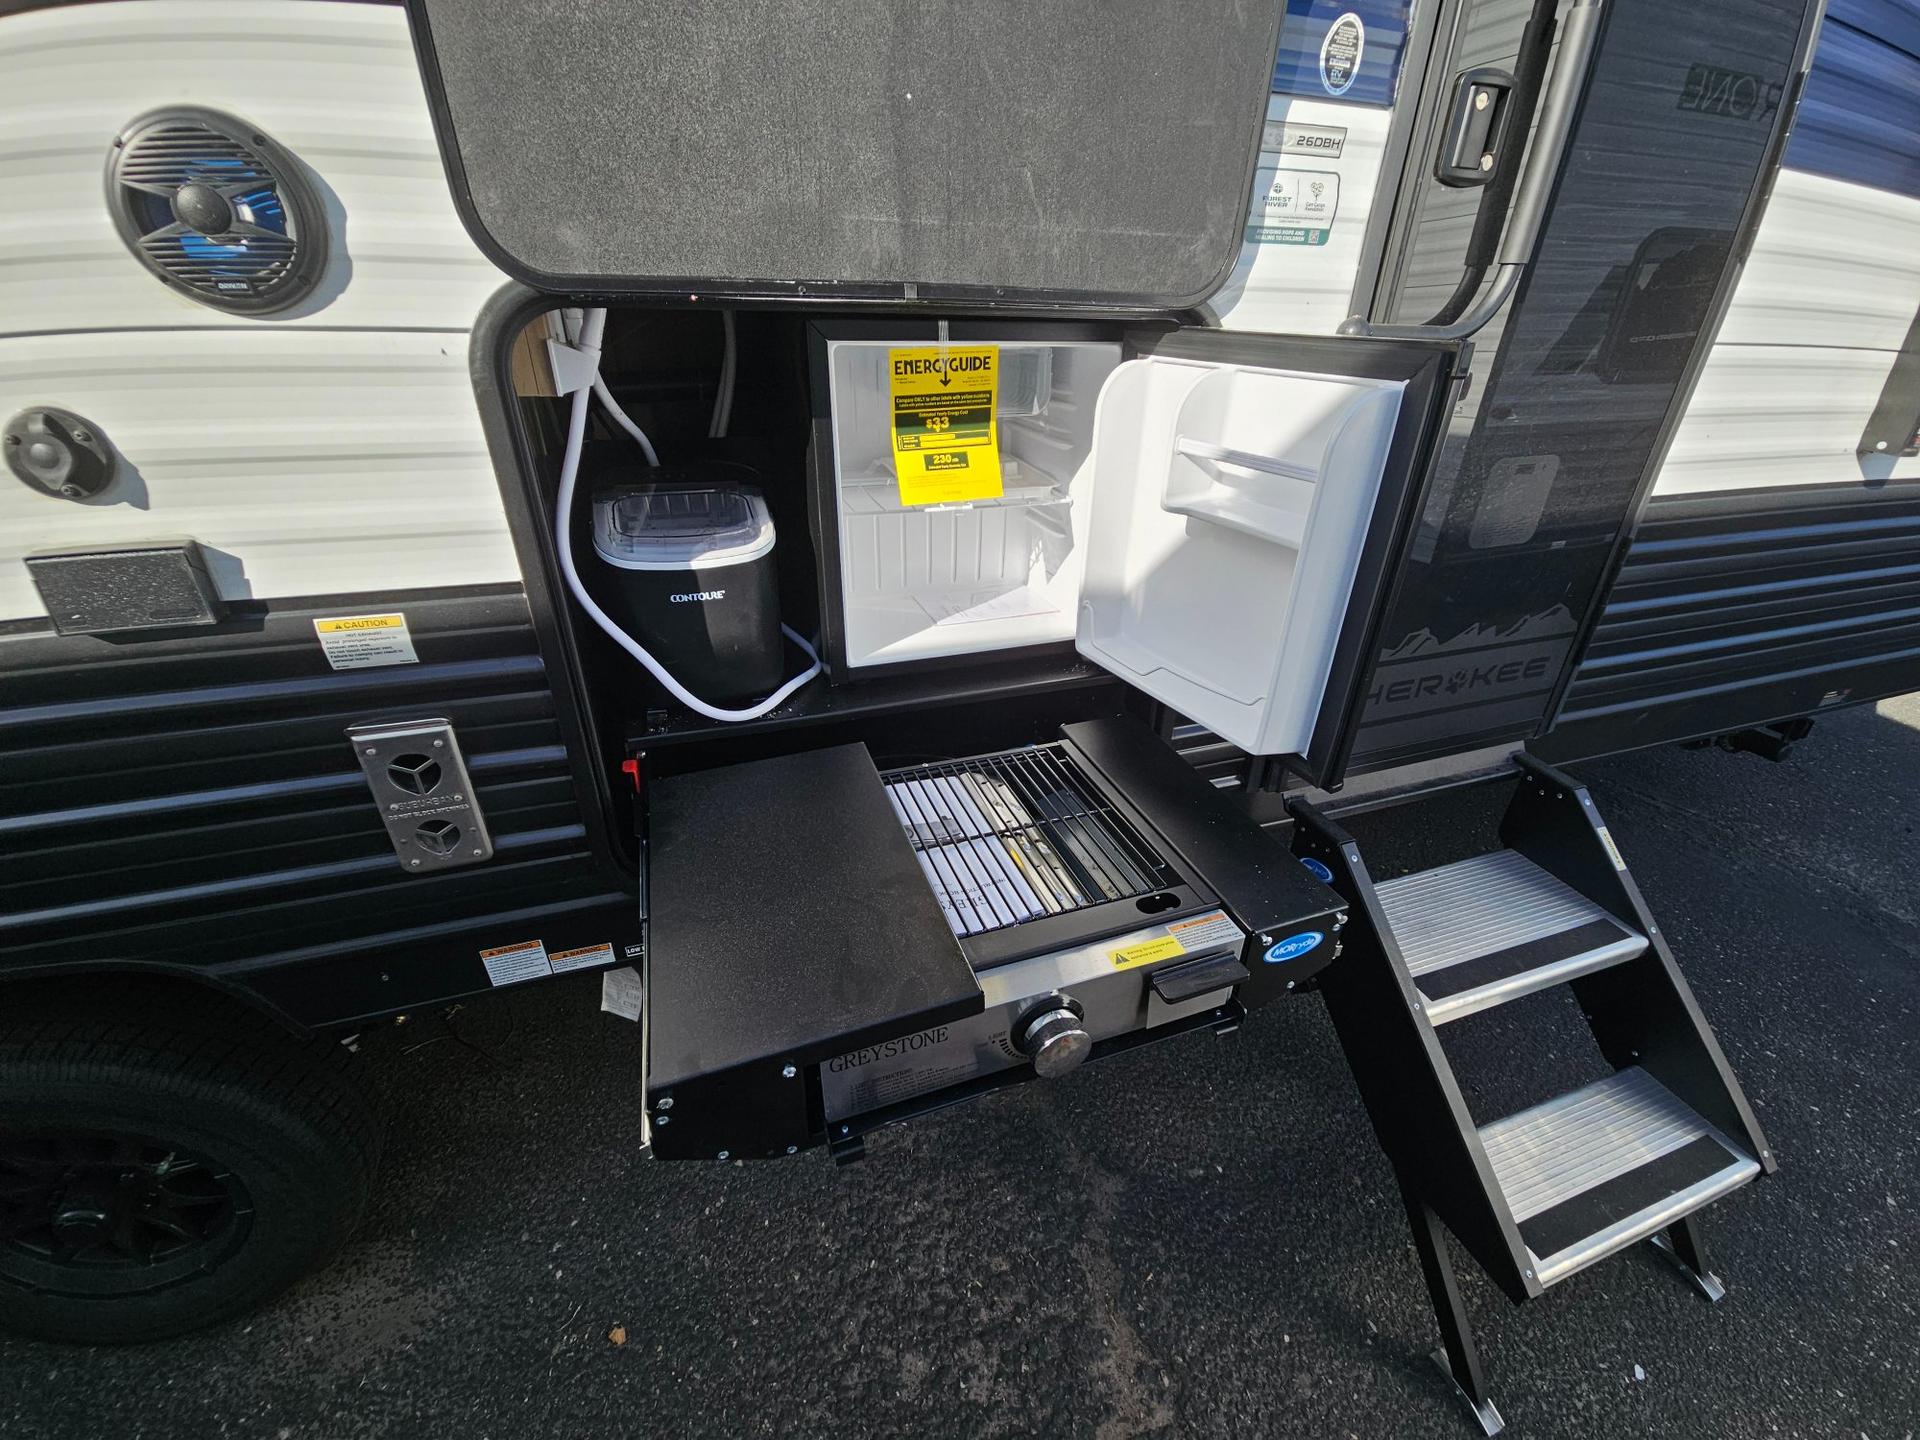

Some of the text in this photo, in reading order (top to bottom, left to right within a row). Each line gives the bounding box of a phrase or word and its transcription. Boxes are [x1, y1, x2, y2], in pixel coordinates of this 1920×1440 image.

[1296, 136, 1341, 149] 26DBH
[932, 454, 952, 464] 230
[670, 591, 724, 603] CONTOURE
[344, 620, 388, 629] CAUTION
[398, 796, 453, 810] SUBURBAN
[829, 1026, 949, 1073] GREYSTONE
